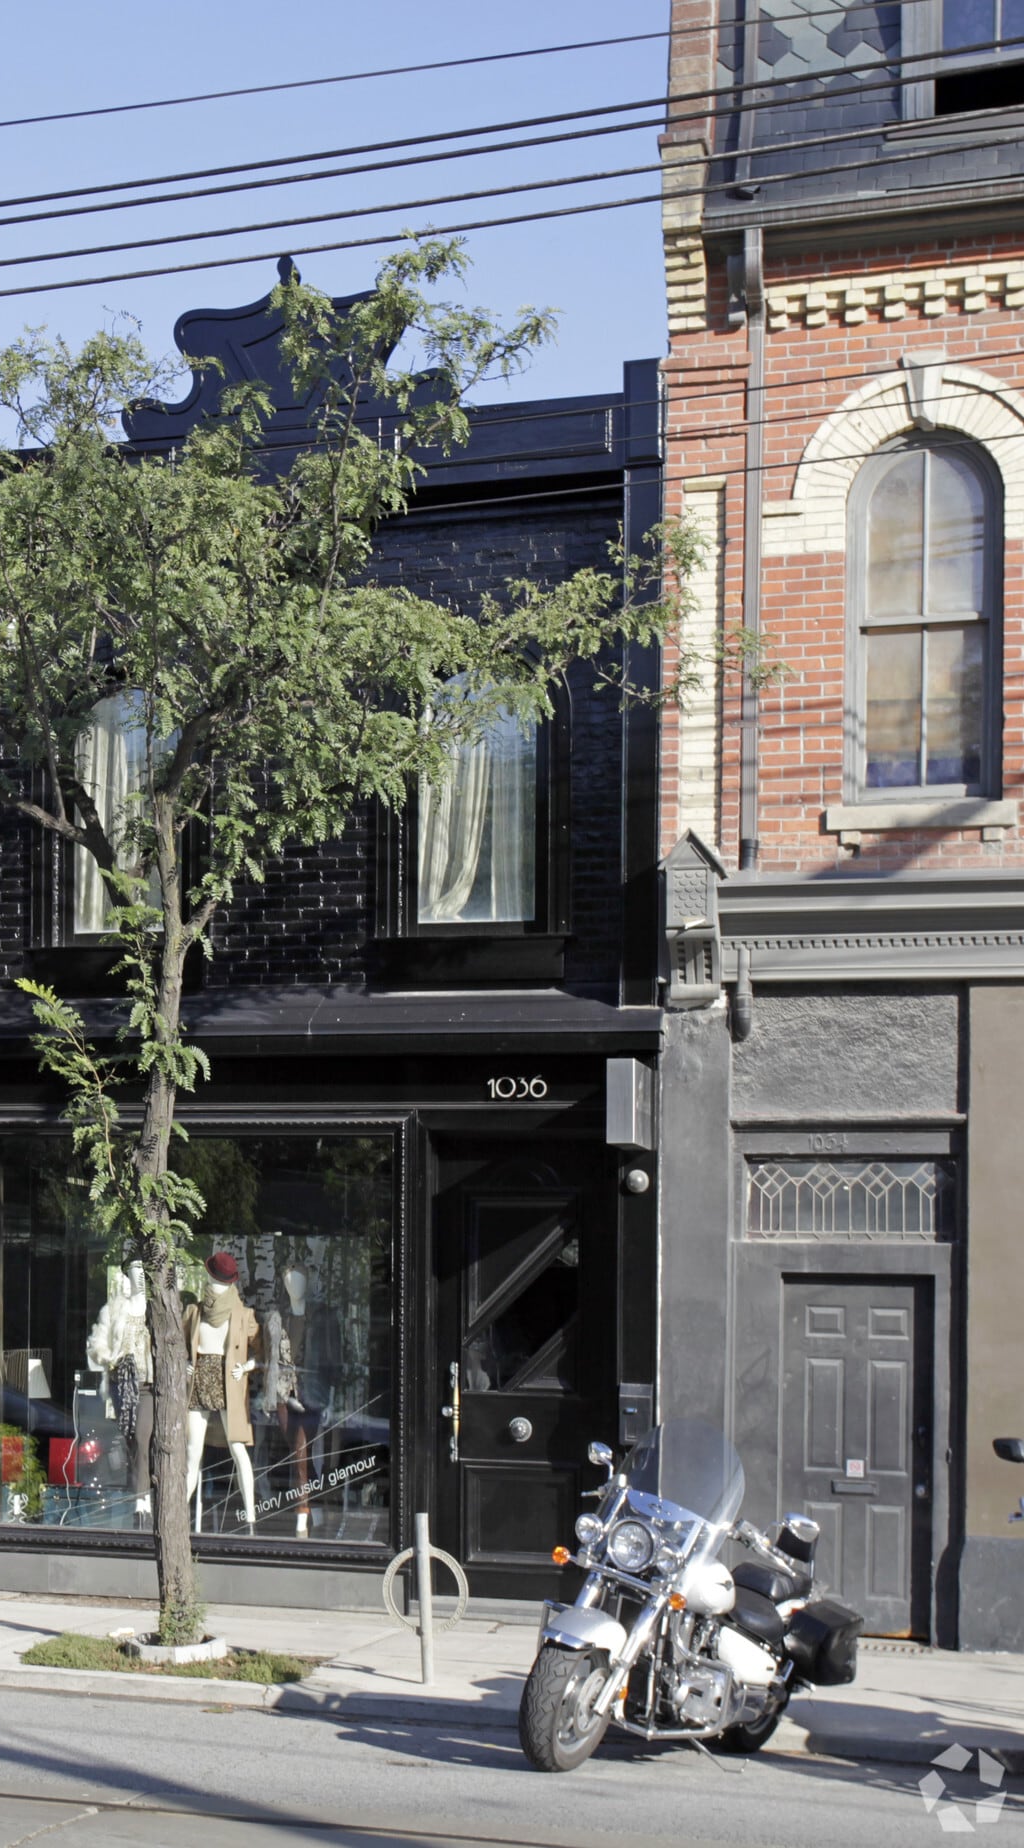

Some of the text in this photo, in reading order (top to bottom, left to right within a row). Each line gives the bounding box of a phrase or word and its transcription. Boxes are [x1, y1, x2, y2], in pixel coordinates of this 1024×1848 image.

[487, 1075, 548, 1099] 1036
[235, 1454, 377, 1523] fahion/ music/ glamour
